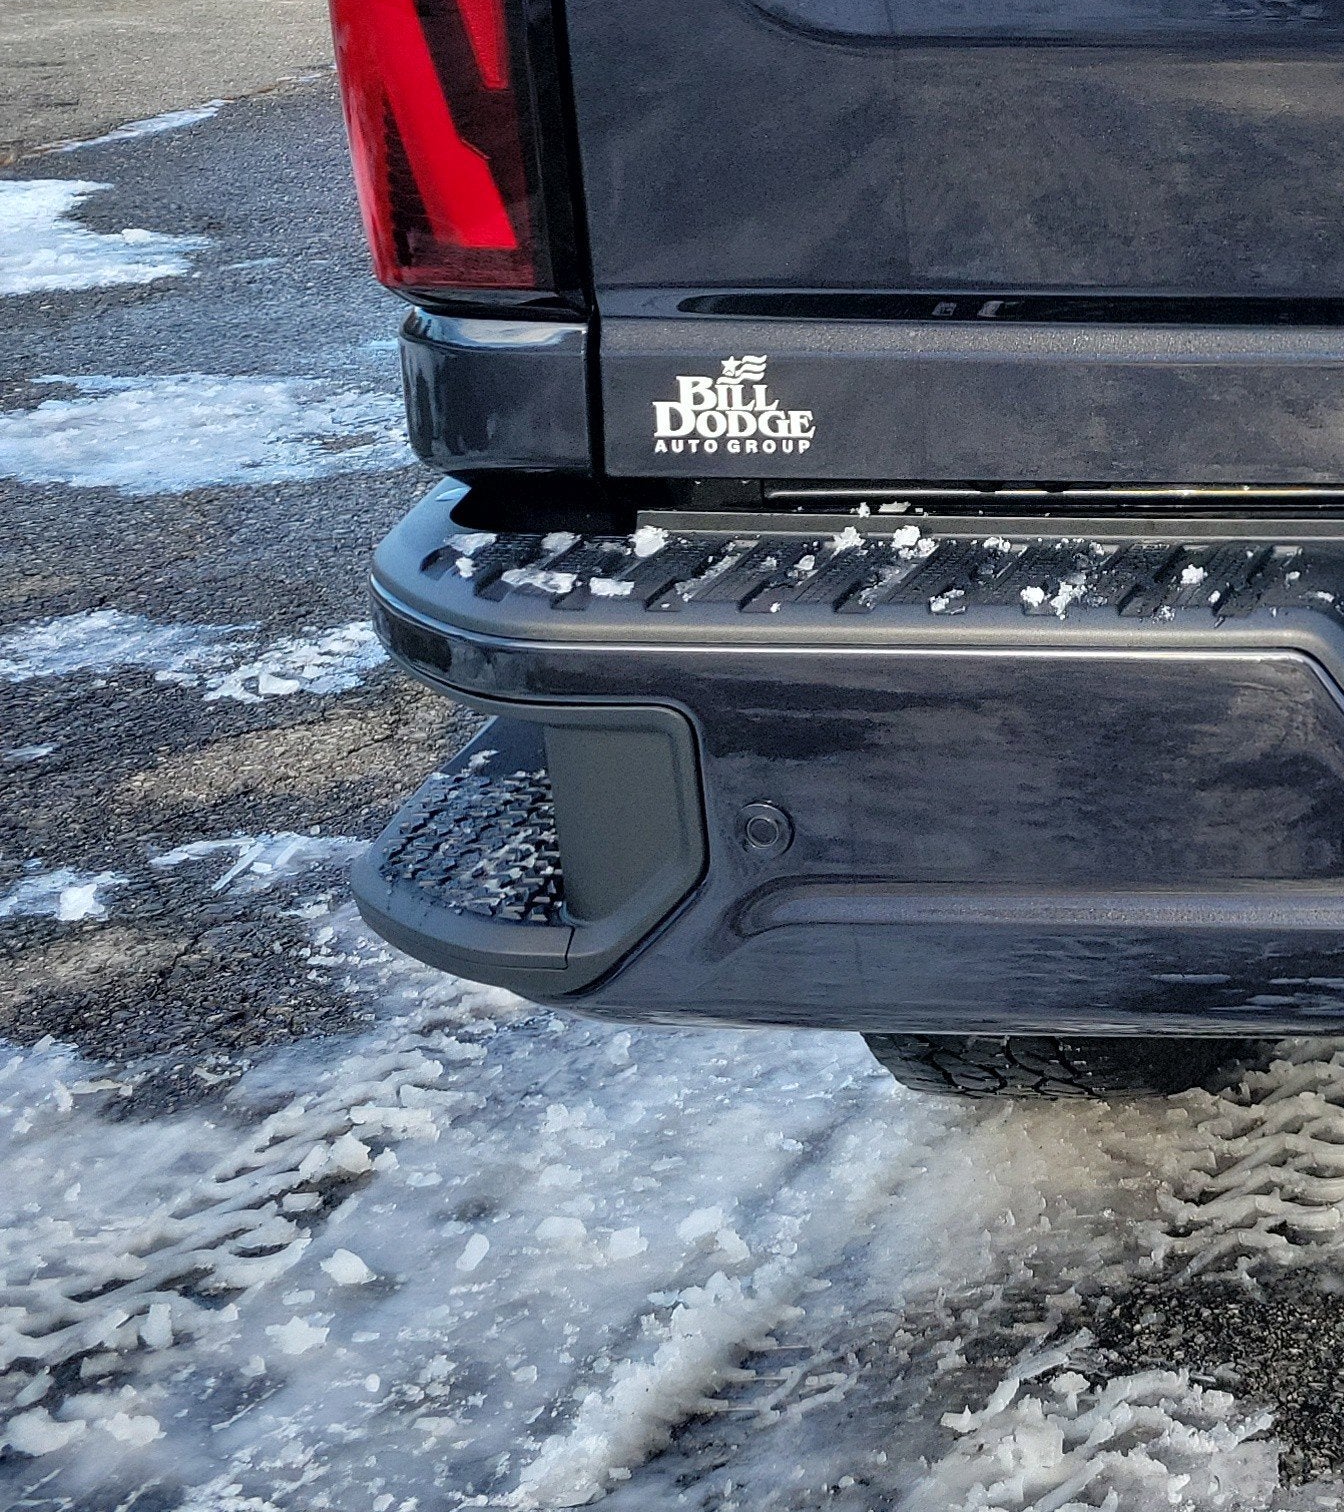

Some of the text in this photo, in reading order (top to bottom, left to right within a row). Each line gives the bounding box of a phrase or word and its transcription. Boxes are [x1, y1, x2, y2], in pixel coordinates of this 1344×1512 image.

[676, 375, 779, 411] BILL
[652, 401, 816, 438] DODGE
[654, 439, 812, 454] AUTO GROUP
